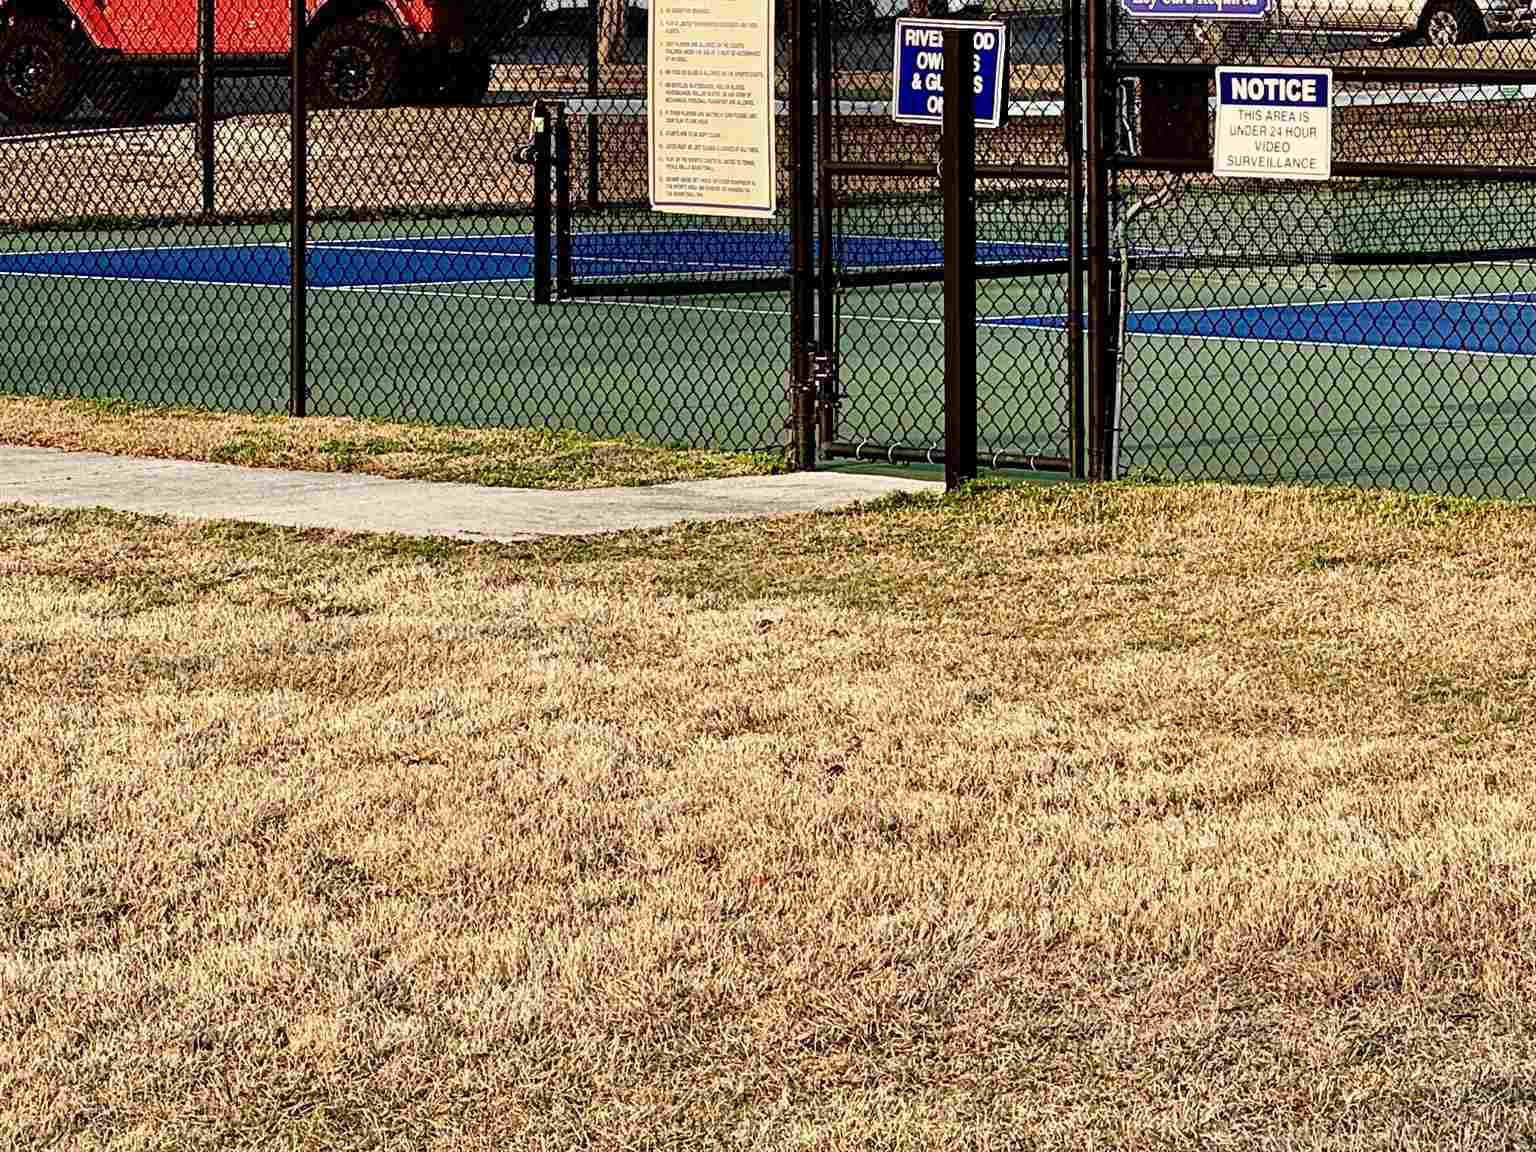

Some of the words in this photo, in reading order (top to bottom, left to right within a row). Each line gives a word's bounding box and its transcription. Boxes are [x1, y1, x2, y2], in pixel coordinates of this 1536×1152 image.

[905, 29, 995, 50] RIVEOD
[911, 72, 922, 90] &
[1231, 77, 1317, 102] NOTICE
[1239, 109, 1263, 121] THIS
[1265, 110, 1296, 122] AREA
[1299, 111, 1310, 123] IS
[1230, 124, 1267, 137] UNDER
[1270, 126, 1282, 138] 24
[1285, 127, 1317, 138] HOUR
[1254, 140, 1291, 153] VIDEO
[1227, 155, 1318, 169] SURVEILLANCE
